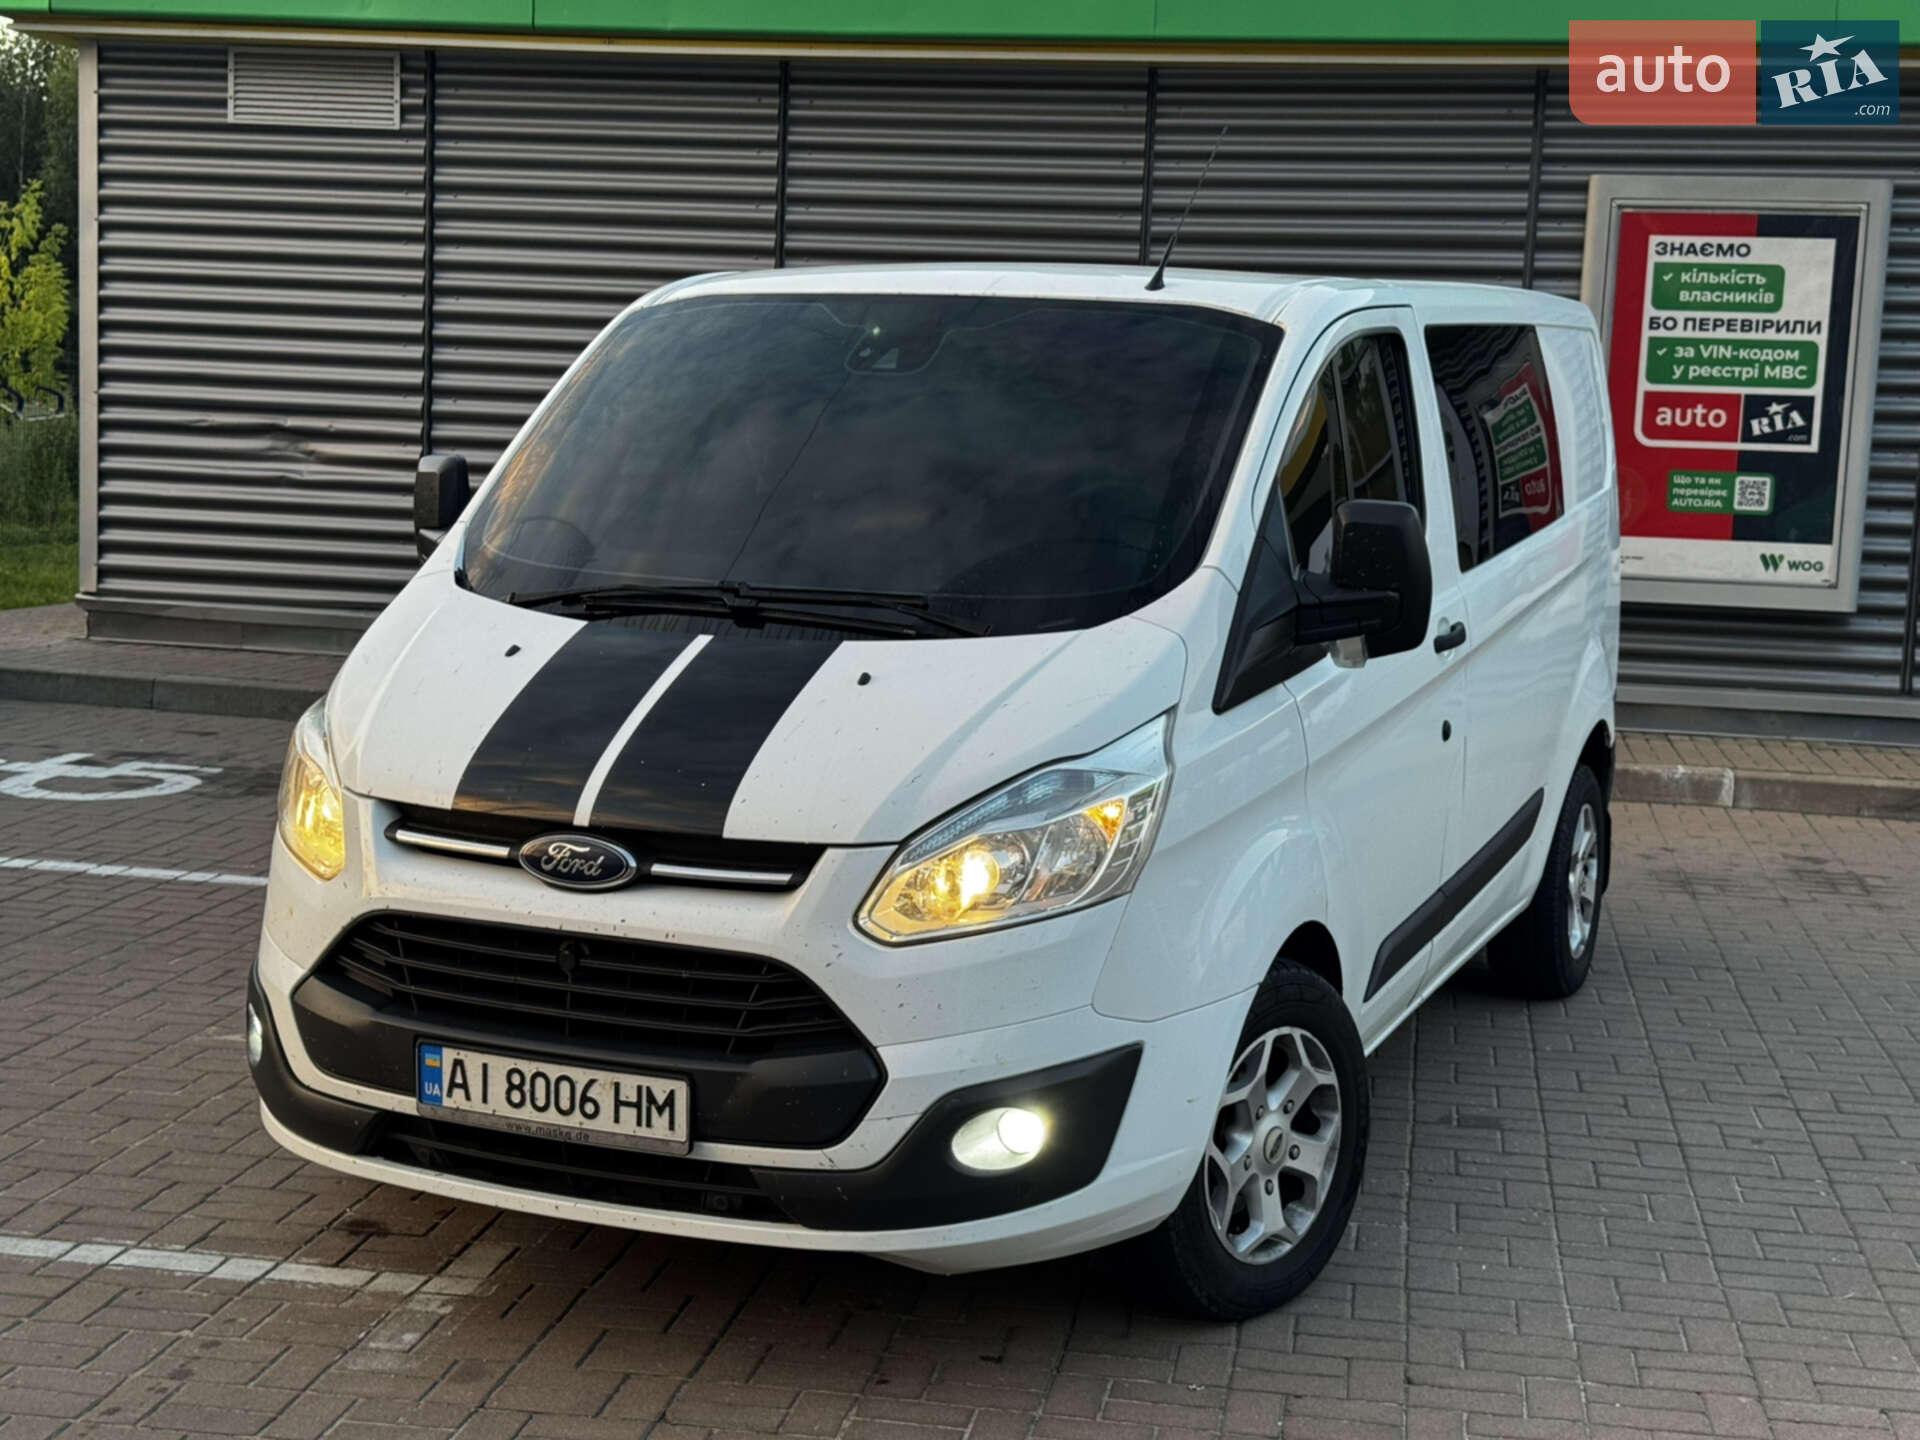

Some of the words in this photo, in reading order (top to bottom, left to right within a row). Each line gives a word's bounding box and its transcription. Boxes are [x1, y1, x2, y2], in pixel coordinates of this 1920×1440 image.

[1654, 241, 1751, 258] ЗНАЄМО
[1680, 268, 1767, 286] кількість
[1679, 287, 1775, 304] власників
[1648, 316, 1677, 332] БО
[1683, 317, 1822, 335] ПЕРЕВІРИЛИ
[1674, 345, 1695, 358] за
[1700, 344, 1800, 362] VIN-кодом
[1672, 365, 1684, 379] у
[1688, 363, 1759, 381] реєстрі
[1764, 364, 1808, 381] МВС
[1655, 403, 1727, 428] auto
[1750, 409, 1807, 437] RIA
[1672, 498, 1723, 509] AUTO.RIA
[1787, 560, 1824, 573] WOG
[541, 842, 605, 876] Ford
[424, 1082, 441, 1097] UA
[446, 1058, 489, 1104] AI
[505, 1067, 600, 1120] 8006
[613, 1081, 676, 1132] HM
